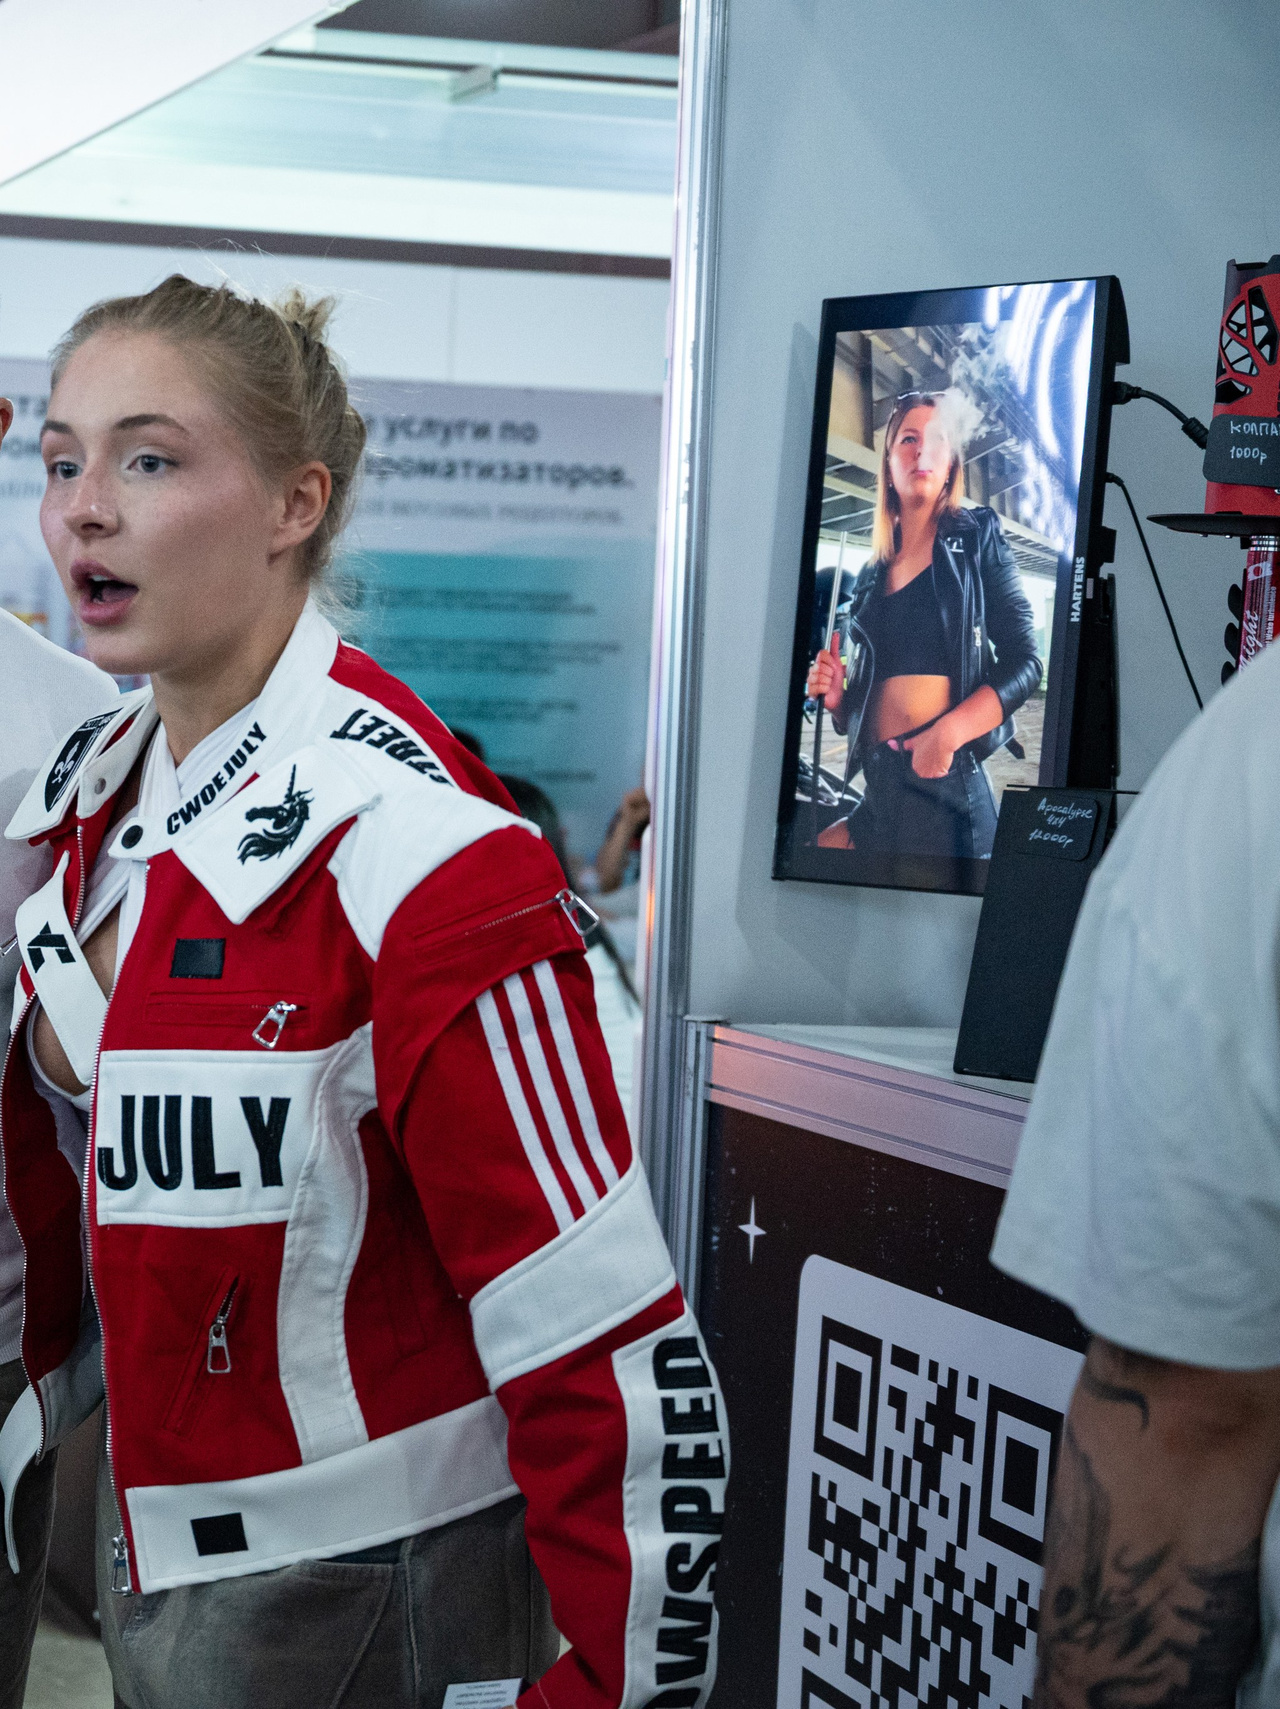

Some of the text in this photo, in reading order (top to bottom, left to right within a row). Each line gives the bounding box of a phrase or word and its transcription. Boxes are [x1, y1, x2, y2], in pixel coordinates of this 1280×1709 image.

[383, 417, 492, 448] услуги
[499, 420, 539, 444] по
[1230, 420, 1280, 436] КОЛПА
[1070, 556, 1085, 623] HARTENS
[166, 721, 268, 836] CWOEJULY
[97, 1094, 292, 1191] JULY
